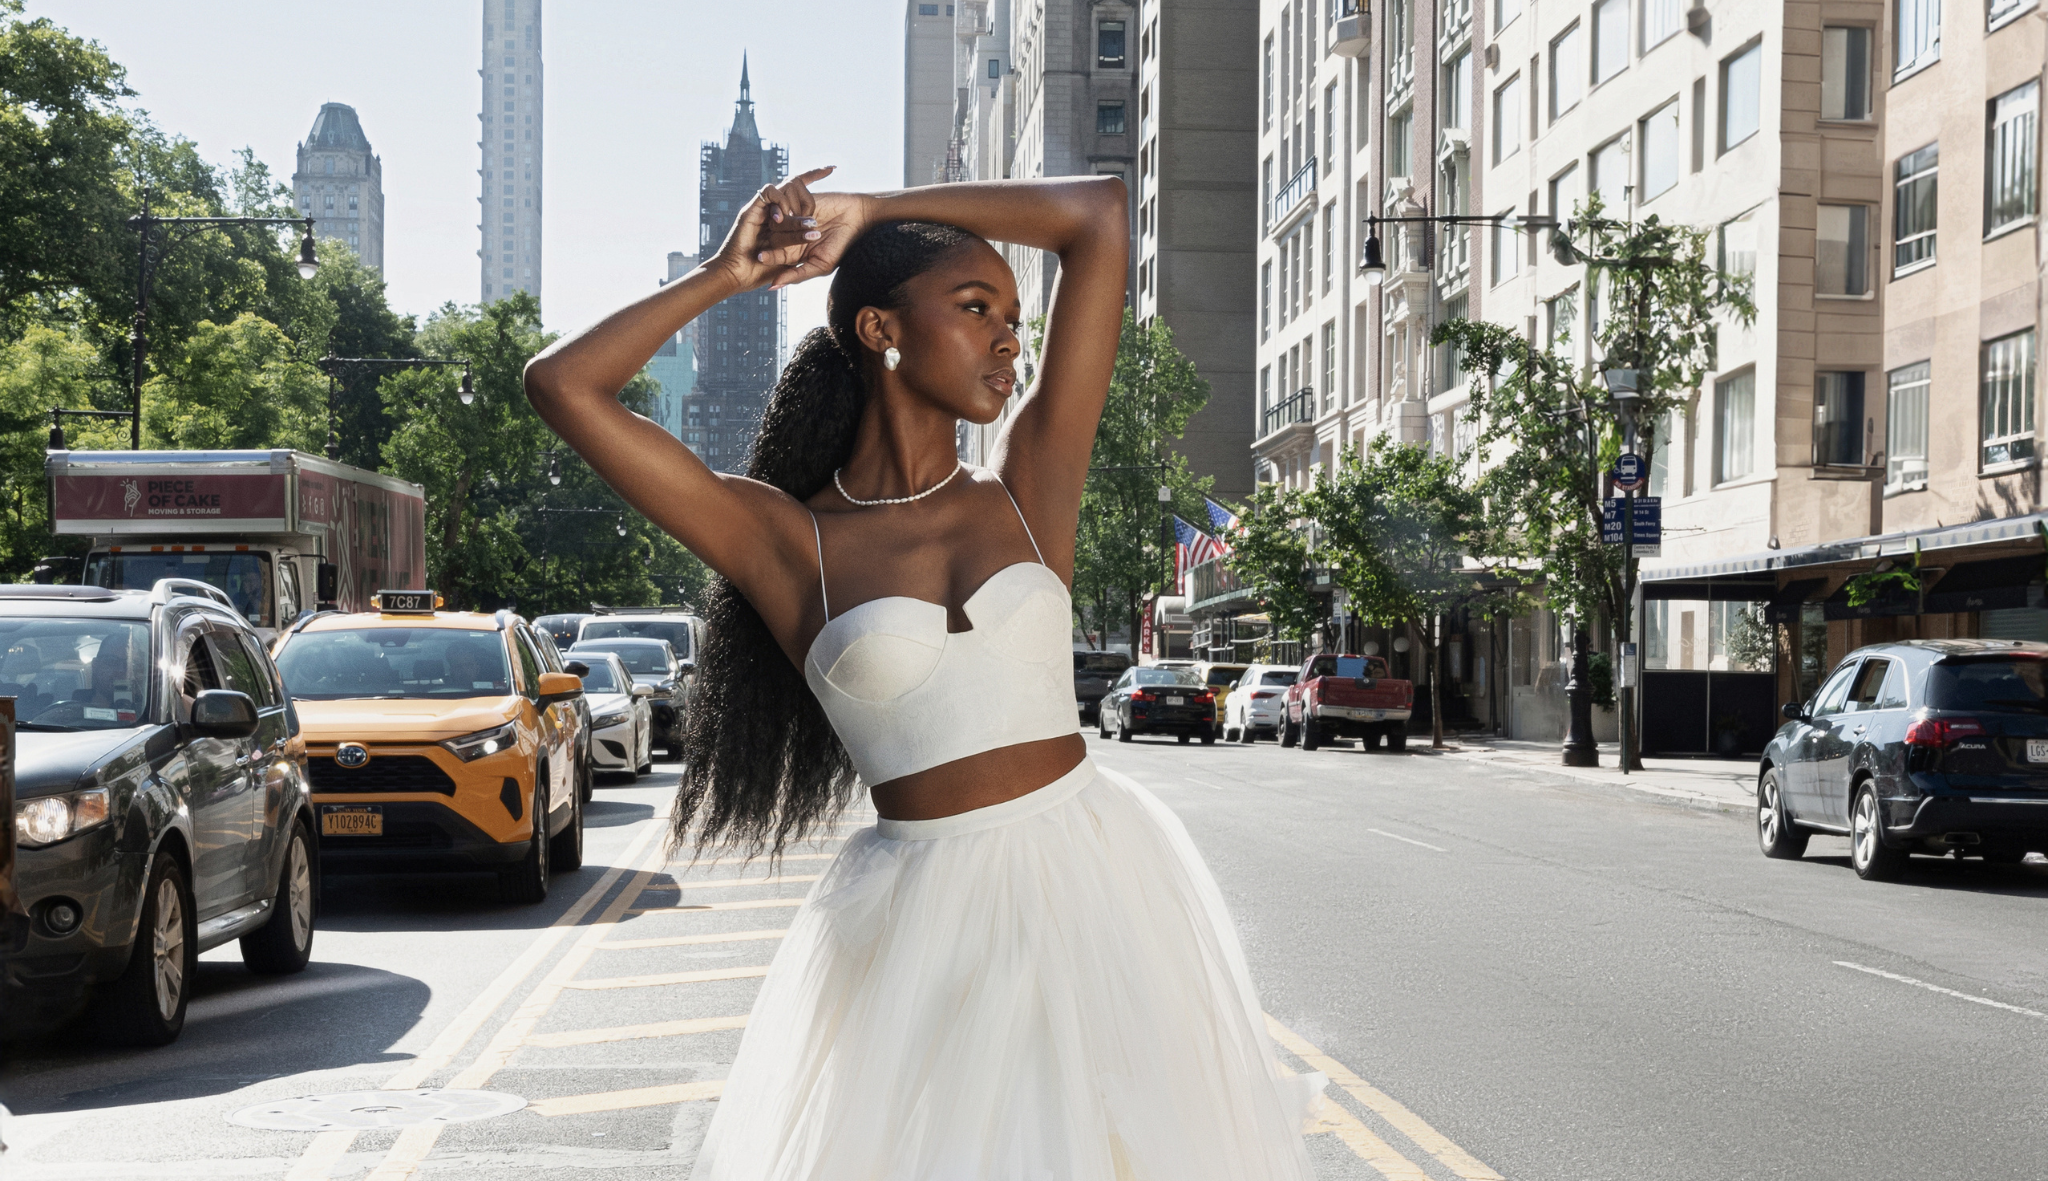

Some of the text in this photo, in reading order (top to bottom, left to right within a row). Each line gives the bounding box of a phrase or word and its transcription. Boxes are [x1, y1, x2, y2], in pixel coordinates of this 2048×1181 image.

[148, 480, 194, 493] PIECE
[148, 494, 220, 507] OF CAKE
[1604, 499, 1617, 508] M5
[1604, 510, 1617, 519] M7
[1604, 521, 1622, 530] M20
[1604, 533, 1624, 542] M104
[389, 595, 421, 609] 7C87
[1143, 611, 1151, 645] PARK
[328, 814, 377, 829] Y102894C
